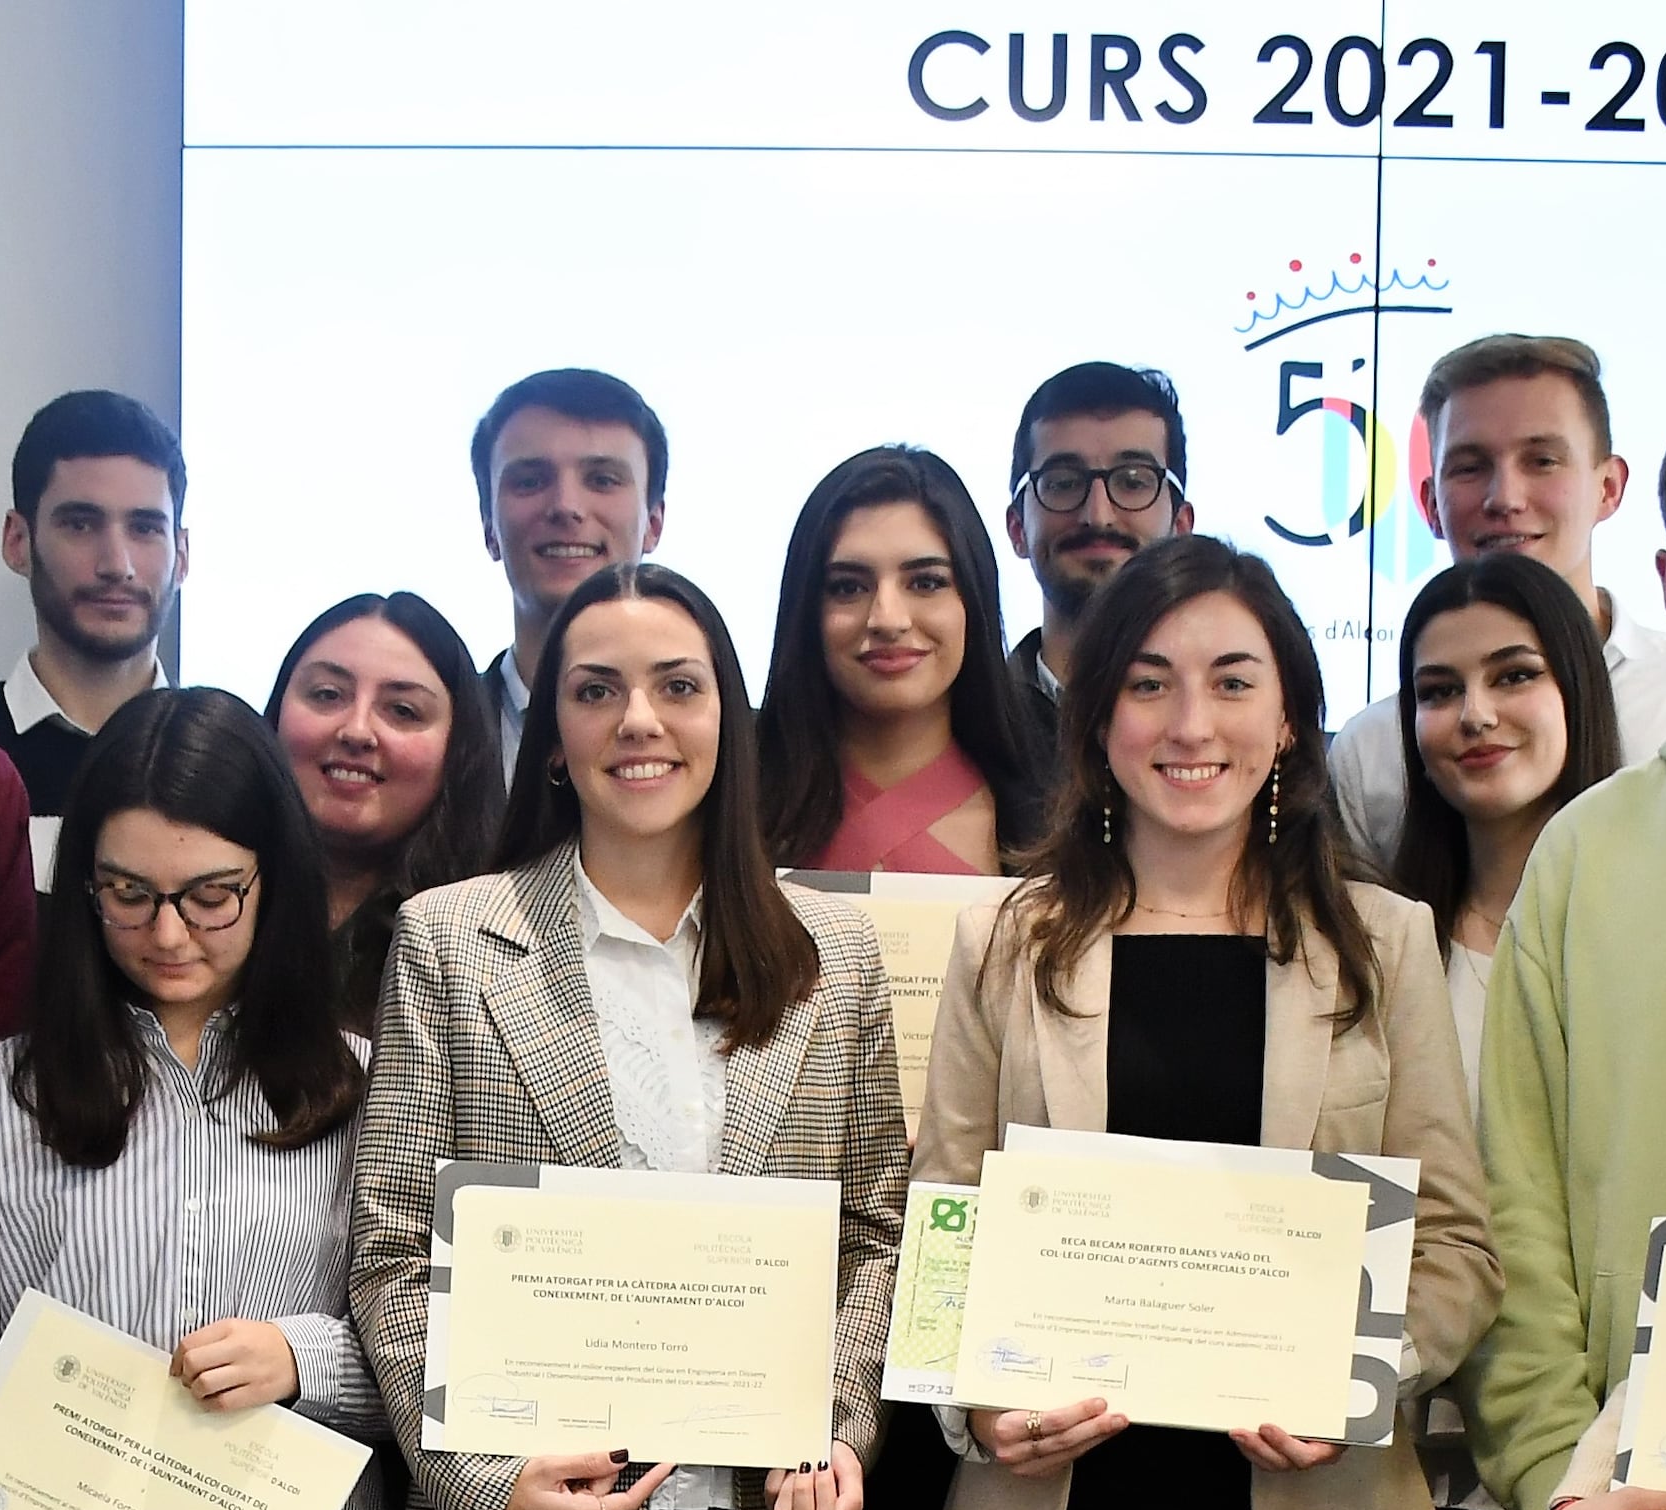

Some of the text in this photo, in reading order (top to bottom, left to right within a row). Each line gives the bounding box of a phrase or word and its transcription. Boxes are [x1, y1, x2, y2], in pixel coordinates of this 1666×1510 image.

[907, 28, 1208, 125] CURS
[1060, 1236, 1087, 1247] BECA
[1089, 1239, 1126, 1250] BECAM
[1128, 1242, 1176, 1255] ROBERTO
[1178, 1247, 1217, 1258] BLANES
[1252, 1253, 1271, 1263] DEL
[755, 1258, 789, 1267] D'ALCOI
[1086, 1252, 1125, 1264] OFICIAL
[1127, 1256, 1179, 1268] D'AGENTS
[1180, 1261, 1246, 1275] COMERCIALS
[1248, 1267, 1290, 1278] D'ALCOI
[511, 1274, 767, 1295] PREMI ATORGAT PER LA CÀTEDRA ALCOI CIUTAT DEL
[532, 1289, 744, 1308] CONEIXEMENT, DE L'AJUNTAMENT D'ALCOI
[1104, 1295, 1215, 1313] Marta Balaguer Soler
[611, 1339, 657, 1351] Montero
[51, 1402, 82, 1422] PREMI
[80, 1416, 124, 1442] ATORGAT
[122, 1436, 141, 1451] PER
[140, 1445, 154, 1457] LA
[152, 1449, 195, 1476] CÀTEDRA
[192, 1470, 221, 1489] ALCOI
[218, 1482, 253, 1505] CIUTAT
[62, 1424, 129, 1462] CONEIXEMENT,
[129, 1455, 143, 1468] DE
[141, 1461, 209, 1499] L'AJUNTAMENT
[75, 1480, 112, 1504] Micaela
